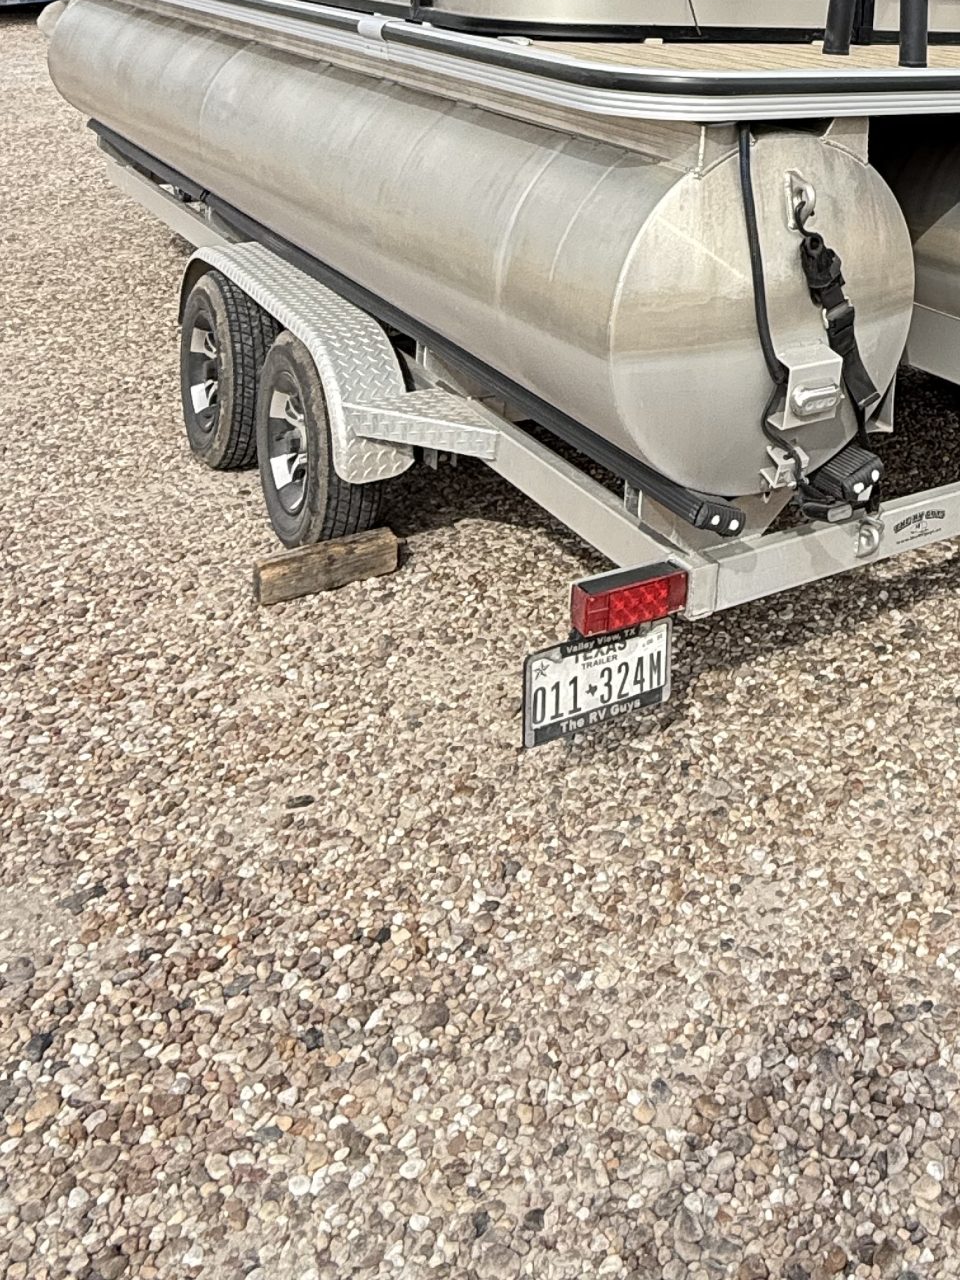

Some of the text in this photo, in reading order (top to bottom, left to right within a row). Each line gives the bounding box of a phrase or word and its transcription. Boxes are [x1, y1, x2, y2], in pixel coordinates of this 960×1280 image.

[566, 639, 596, 654] Valley
[624, 628, 636, 638] TX
[581, 654, 618, 670] TRAILER
[560, 698, 641, 734] The RV Guys
